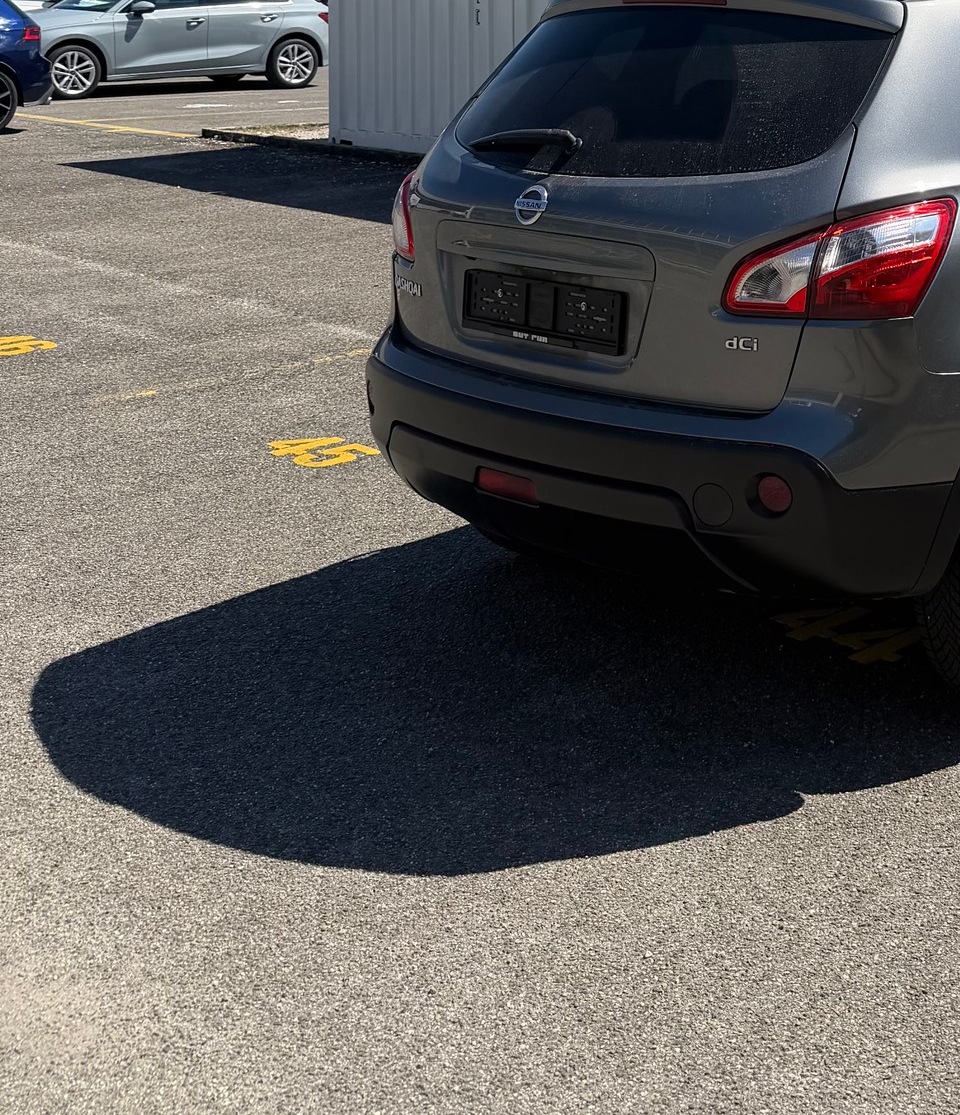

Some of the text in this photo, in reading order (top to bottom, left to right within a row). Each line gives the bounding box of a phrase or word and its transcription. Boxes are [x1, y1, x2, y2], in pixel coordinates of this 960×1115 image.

[516, 200, 542, 209] NISSAN
[725, 337, 758, 351] dCi
[267, 437, 381, 468] 45
